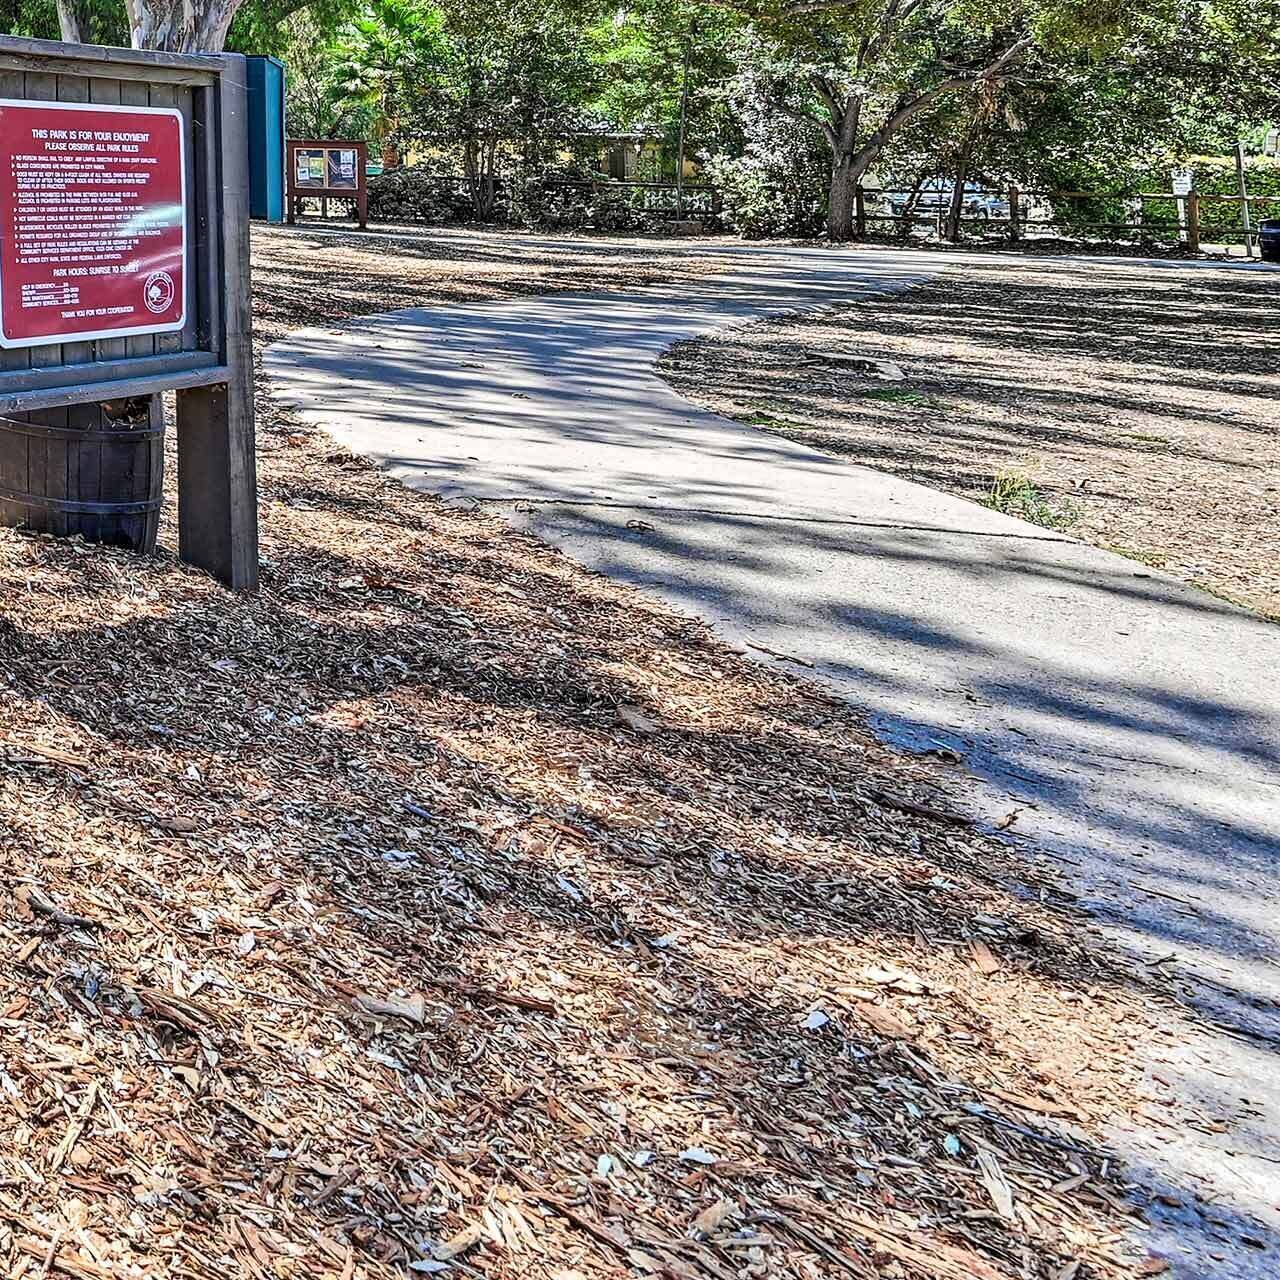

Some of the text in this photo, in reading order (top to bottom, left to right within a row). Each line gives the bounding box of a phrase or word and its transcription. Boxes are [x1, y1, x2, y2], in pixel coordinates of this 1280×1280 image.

[32, 129, 48, 138] THIS
[50, 130, 67, 139] PARK
[70, 131, 76, 139] IS
[79, 131, 92, 140] FOR
[94, 132, 112, 141] YOUR
[45, 142, 67, 150] PLEASE
[68, 143, 94, 151] OBSERVE
[96, 144, 106, 152] ALL
